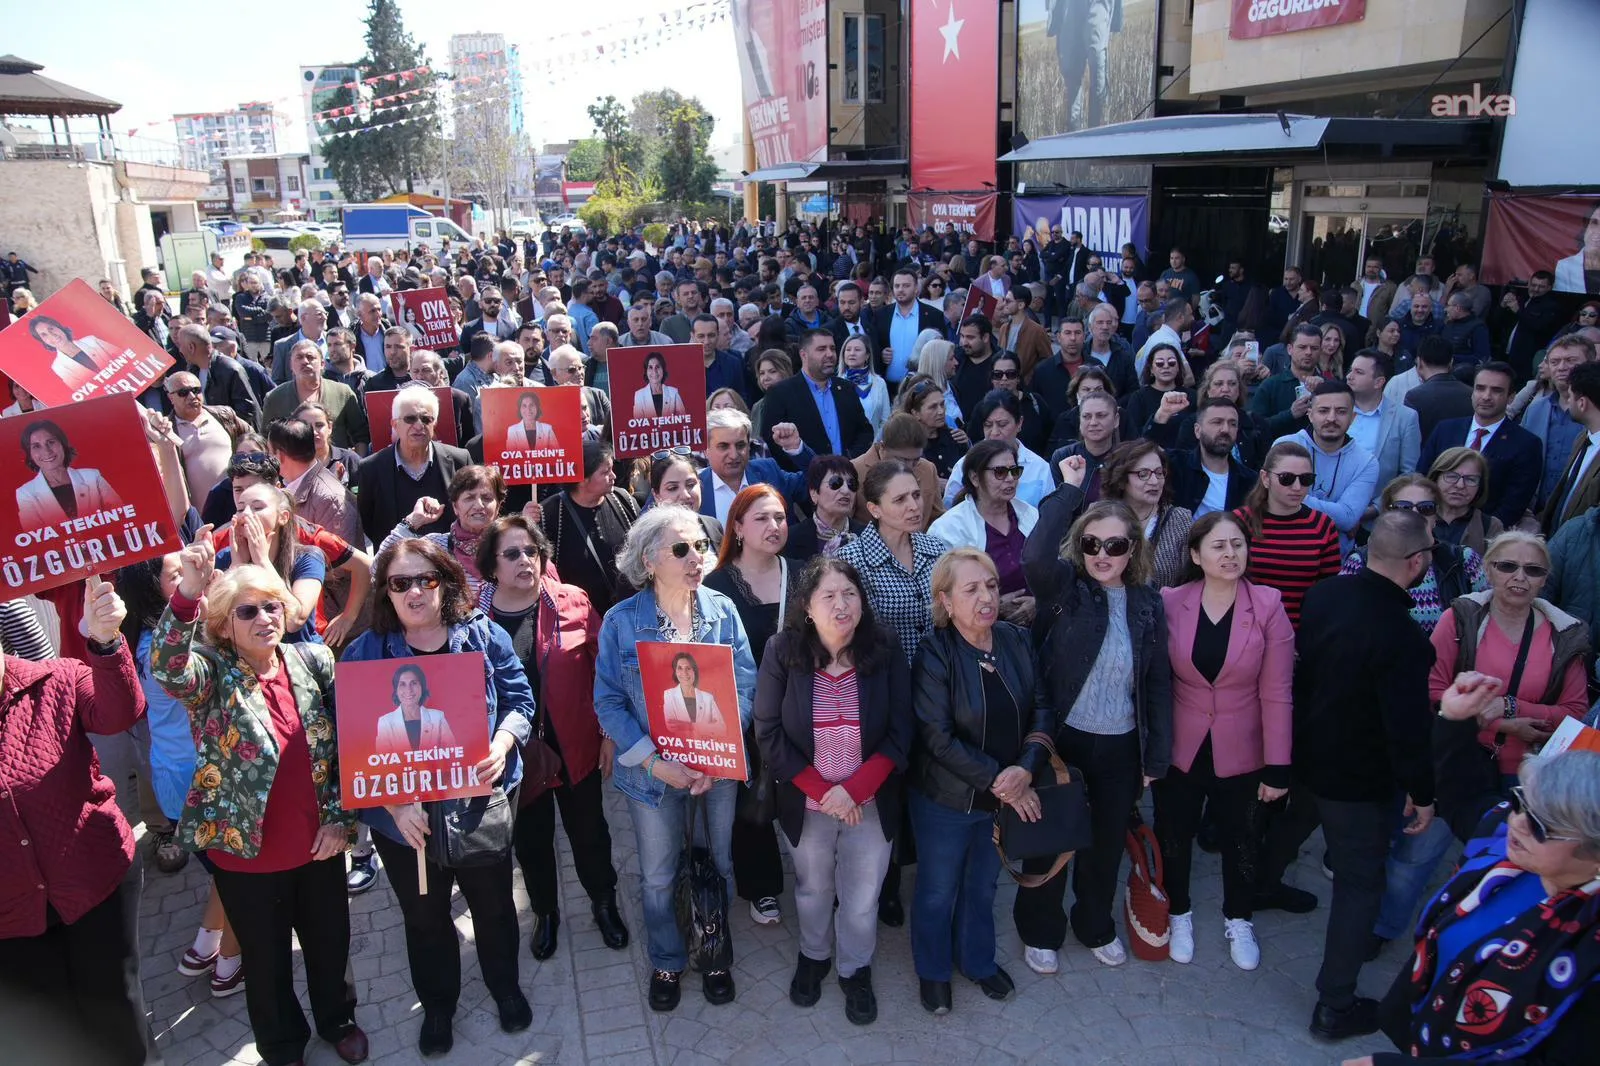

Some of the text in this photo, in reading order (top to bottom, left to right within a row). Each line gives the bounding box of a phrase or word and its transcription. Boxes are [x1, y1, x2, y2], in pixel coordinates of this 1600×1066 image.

[932, 203, 947, 216] OYA
[1061, 206, 1132, 254] ADANA
[421, 299, 449, 320] OYA
[425, 319, 453, 331] TEKİN'E
[71, 348, 137, 402] OYA TEKİN'E
[628, 413, 691, 428] OYA TEKİN'E
[618, 426, 702, 452] ÖZGÜRLÜK
[501, 448, 565, 459] OYA TEKİN'E
[15, 504, 136, 547] OYA TEKİN'E
[2, 521, 164, 588] ÖZGÜRLÜK
[657, 735, 736, 753] OYA TEKİN'E
[368, 745, 464, 766] OYA TEKİN'E
[662, 749, 736, 768] ÖZGÜRLÜK!
[353, 762, 481, 799] ÖZGÜRLÜK
